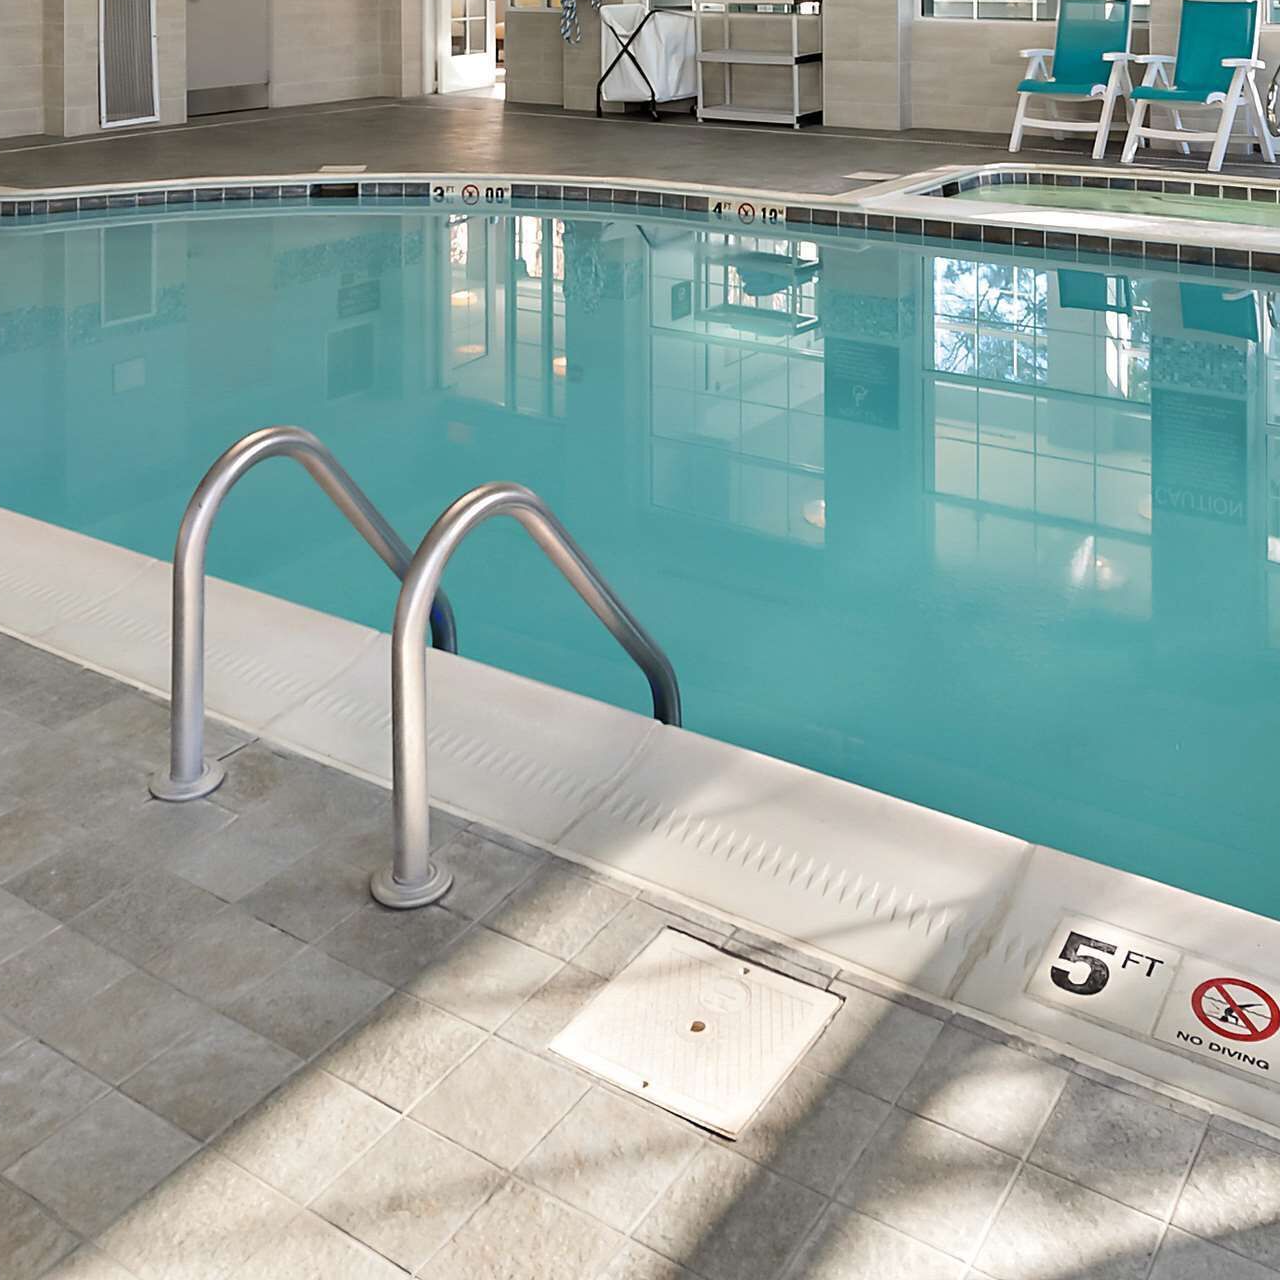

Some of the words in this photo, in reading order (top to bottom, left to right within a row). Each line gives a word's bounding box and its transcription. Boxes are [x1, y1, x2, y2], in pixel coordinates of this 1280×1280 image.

[1050, 931, 1118, 996] 5
[1121, 950, 1165, 977] FT
[1176, 1030, 1203, 1046] NO
[1208, 1042, 1270, 1070] DIVING
